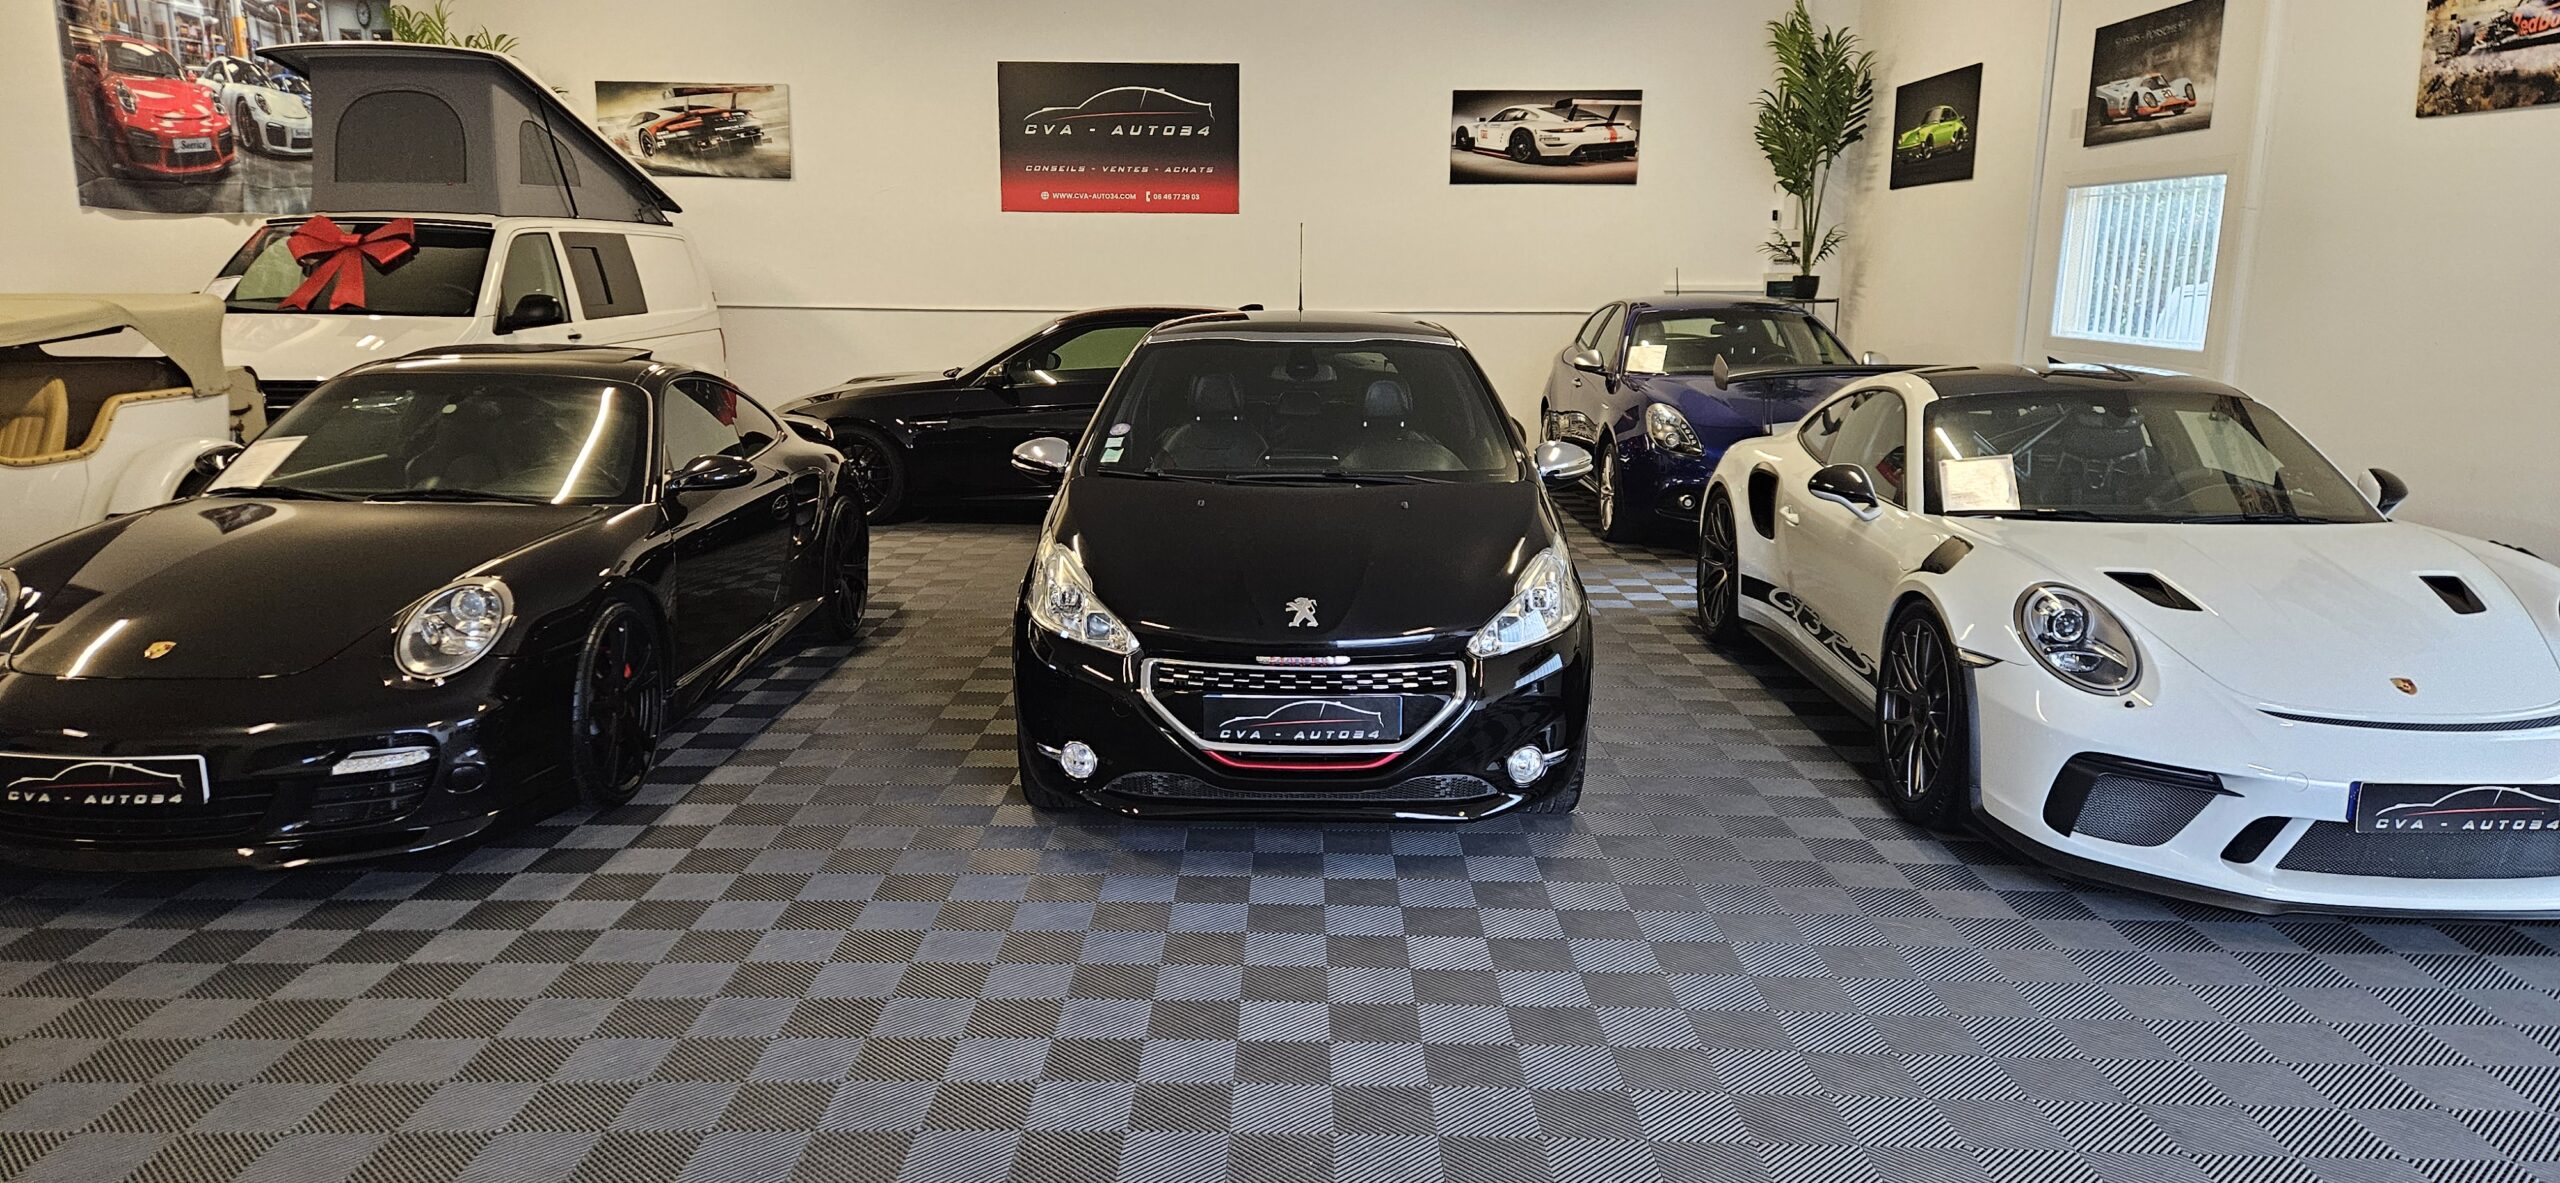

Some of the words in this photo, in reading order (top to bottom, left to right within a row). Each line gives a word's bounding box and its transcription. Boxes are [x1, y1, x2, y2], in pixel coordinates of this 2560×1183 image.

[1024, 124, 1072, 135] CVA
[1111, 125, 1211, 136] AUTO34
[1025, 165, 1086, 173] CONSEILS
[1052, 192, 1136, 200] WWW.CVA-AUTO34.COM
[1219, 729, 1261, 740] CVA
[1294, 729, 1380, 740] AUTO34
[7, 791, 50, 803] CVA
[84, 794, 183, 805] AUTO34
[2375, 818, 2424, 830] CVA
[2462, 819, 2560, 831] AUTO34
